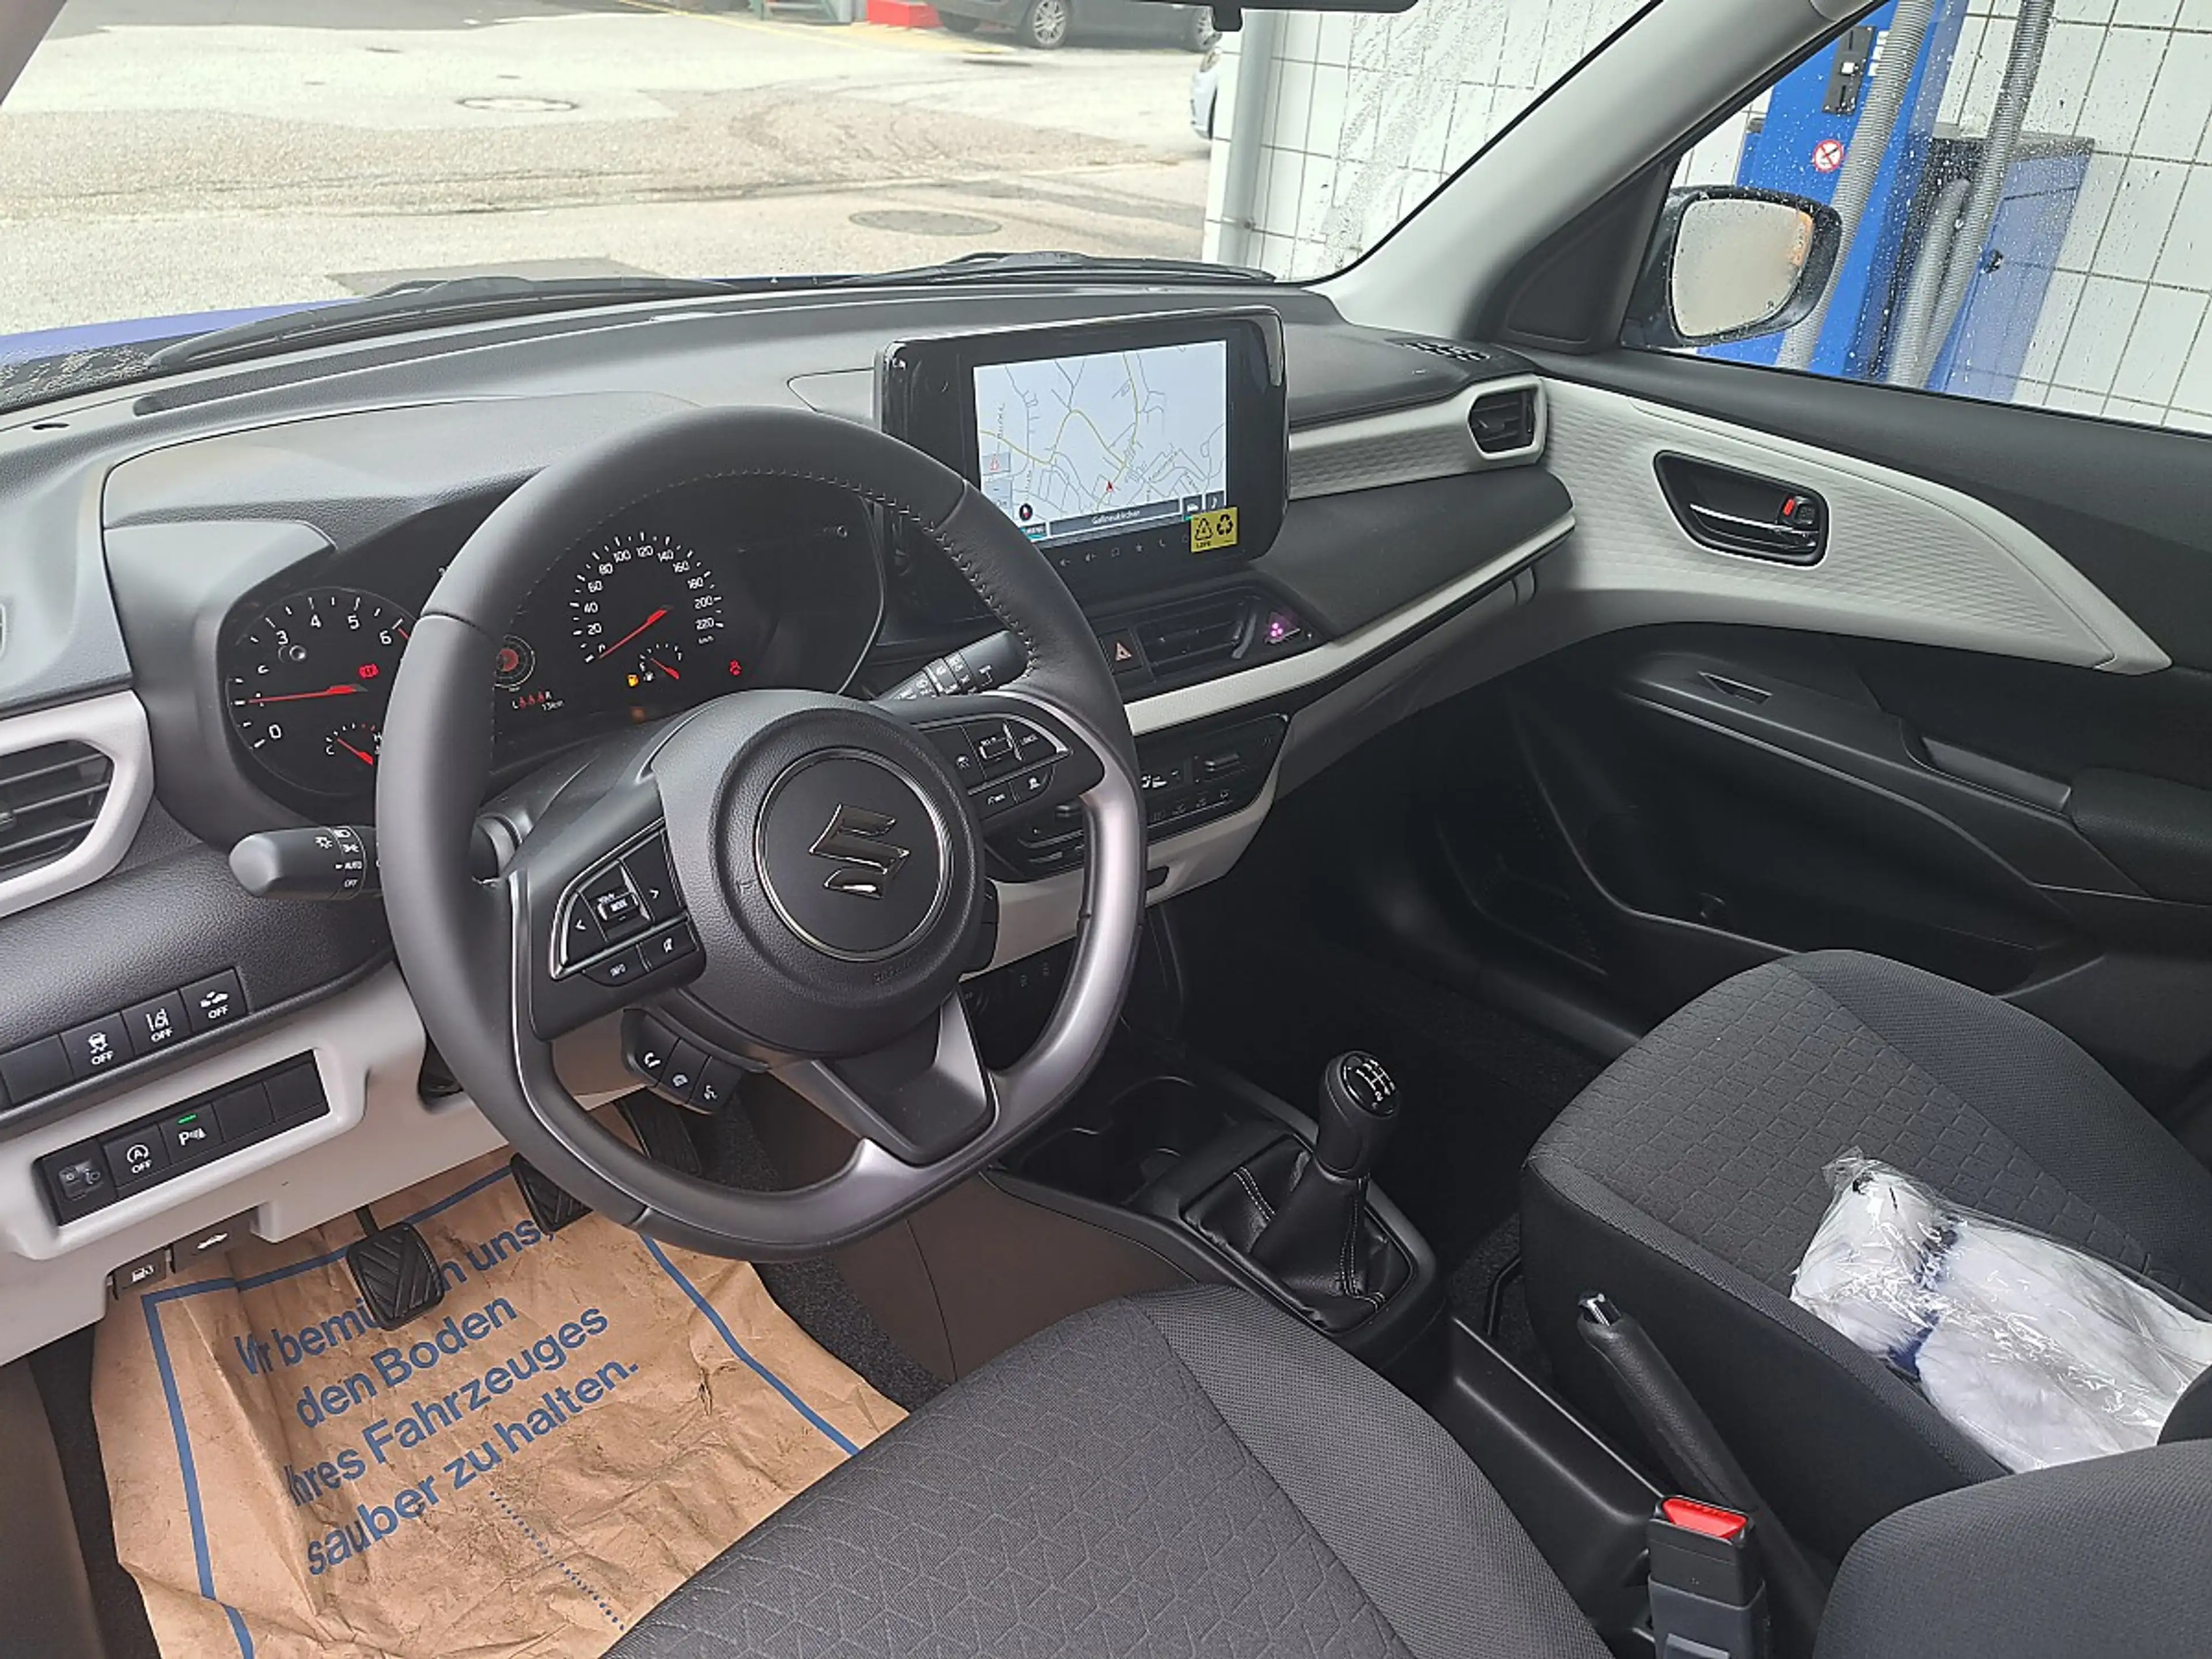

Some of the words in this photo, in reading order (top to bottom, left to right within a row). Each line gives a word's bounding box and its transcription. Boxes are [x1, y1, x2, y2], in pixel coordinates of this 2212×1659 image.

[612, 549, 632, 563] 100
[635, 545, 654, 558] 120
[657, 549, 675, 563] 140
[584, 601, 599, 613] 40
[694, 595, 713, 609] 200
[310, 614, 322, 629] 4
[348, 615, 360, 630] 5
[587, 622, 602, 635] 20
[695, 617, 715, 630] 220
[276, 630, 289, 645] 3
[379, 630, 392, 645] 6
[268, 724, 282, 740] 0
[208, 1004, 228, 1019] OFF
[150, 1027, 173, 1043] OFF
[91, 1050, 113, 1065] OFF
[131, 1159, 152, 1173] OFF
[295, 1371, 377, 1429] den
[370, 1296, 517, 1389] Boden
[283, 1448, 366, 1508] Ihres
[361, 1306, 609, 1465] Fahrzeuges
[307, 1474, 440, 1575] sauber
[442, 1440, 502, 1488] zu
[493, 1359, 639, 1455] halten.
